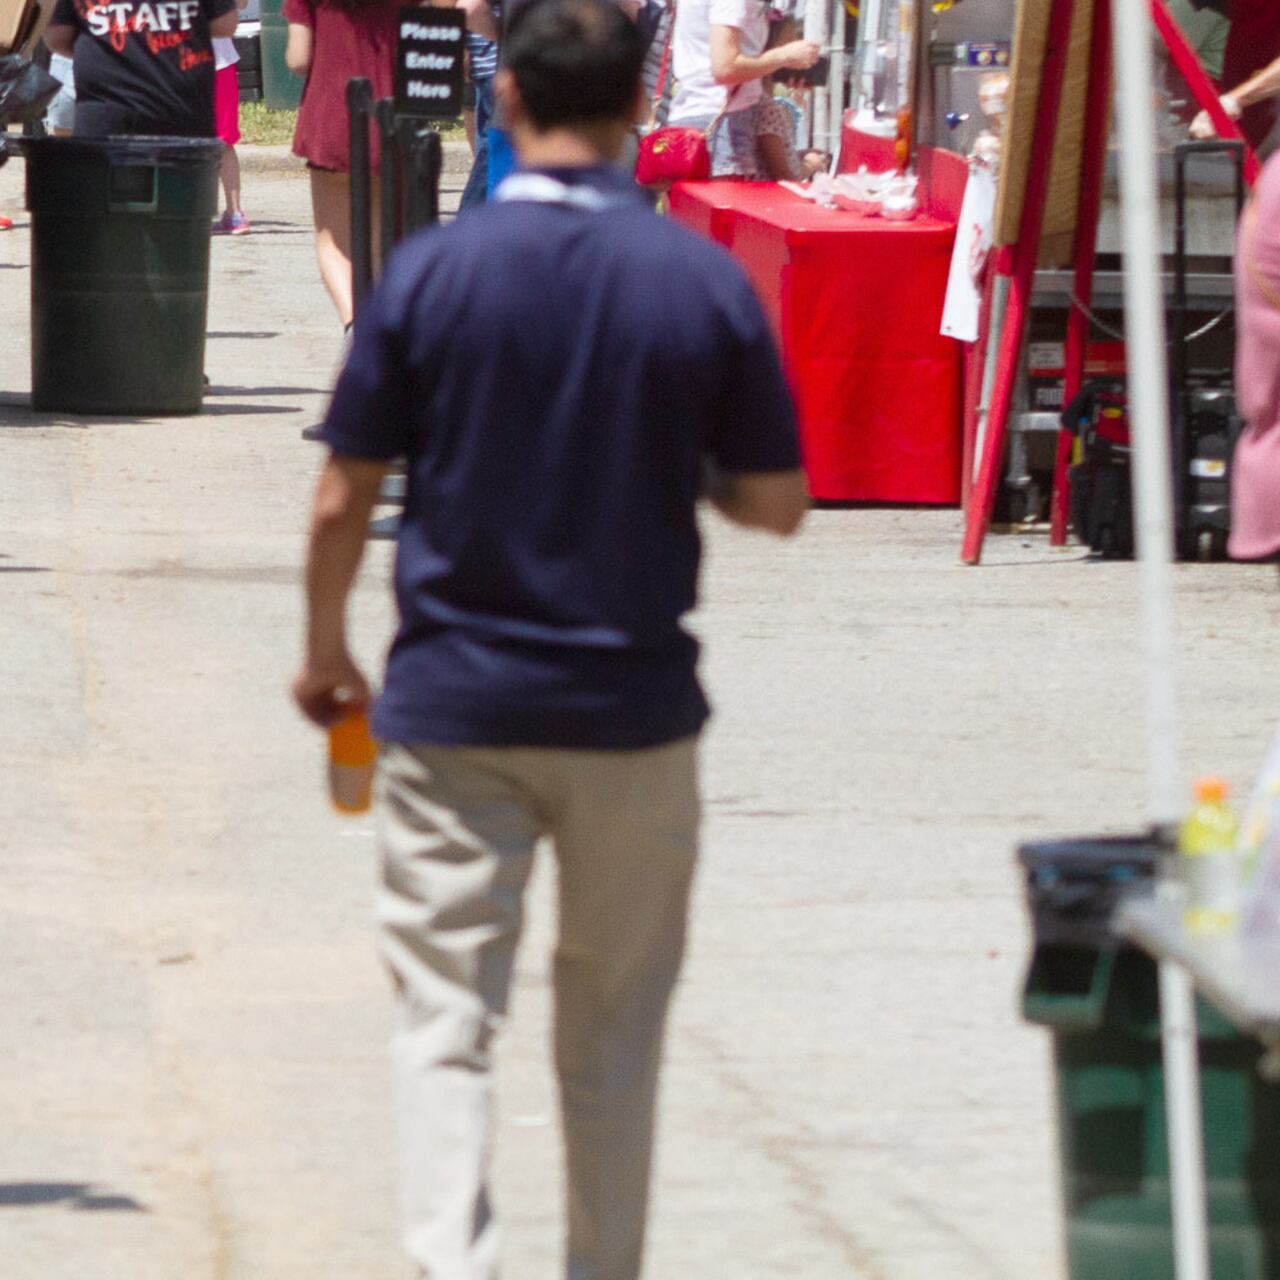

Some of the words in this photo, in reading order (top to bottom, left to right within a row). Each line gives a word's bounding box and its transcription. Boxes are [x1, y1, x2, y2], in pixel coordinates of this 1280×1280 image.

[86, 0, 200, 36] STAFF
[400, 22, 461, 42] Please
[405, 51, 455, 70] Enter
[406, 80, 451, 99] Here
